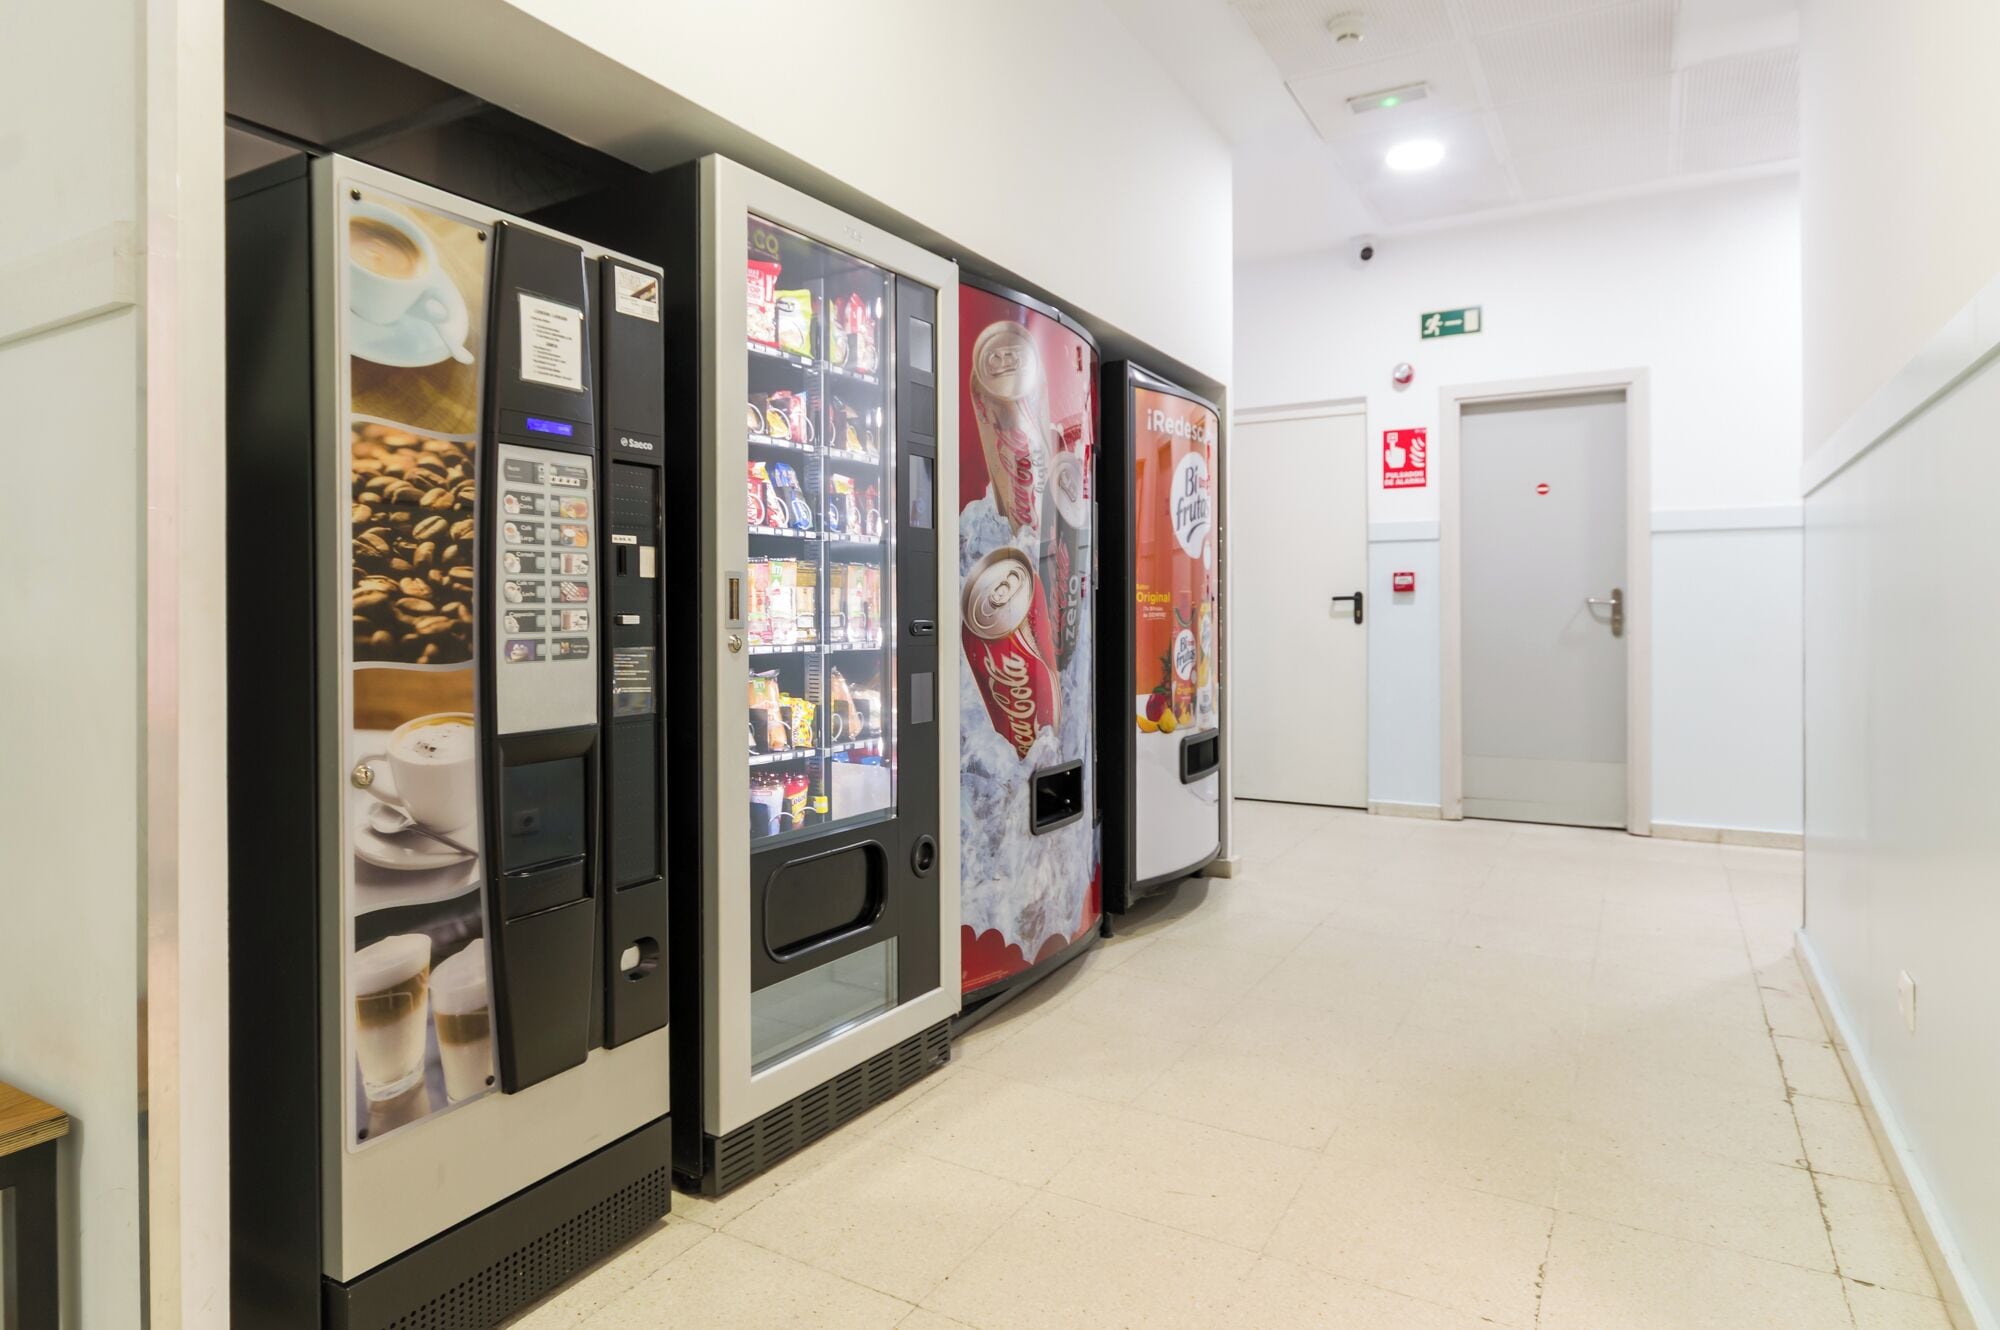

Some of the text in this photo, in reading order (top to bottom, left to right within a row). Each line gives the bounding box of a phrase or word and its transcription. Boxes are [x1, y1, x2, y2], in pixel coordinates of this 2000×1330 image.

[629, 438, 653, 451] Saeco
[1385, 470, 1424, 479] PULSADOR
[1185, 466, 1198, 498] Bi
[1384, 477, 1425, 486] DE ALARMA
[1136, 591, 1171, 605] Original
[1065, 575, 1079, 641] zero
